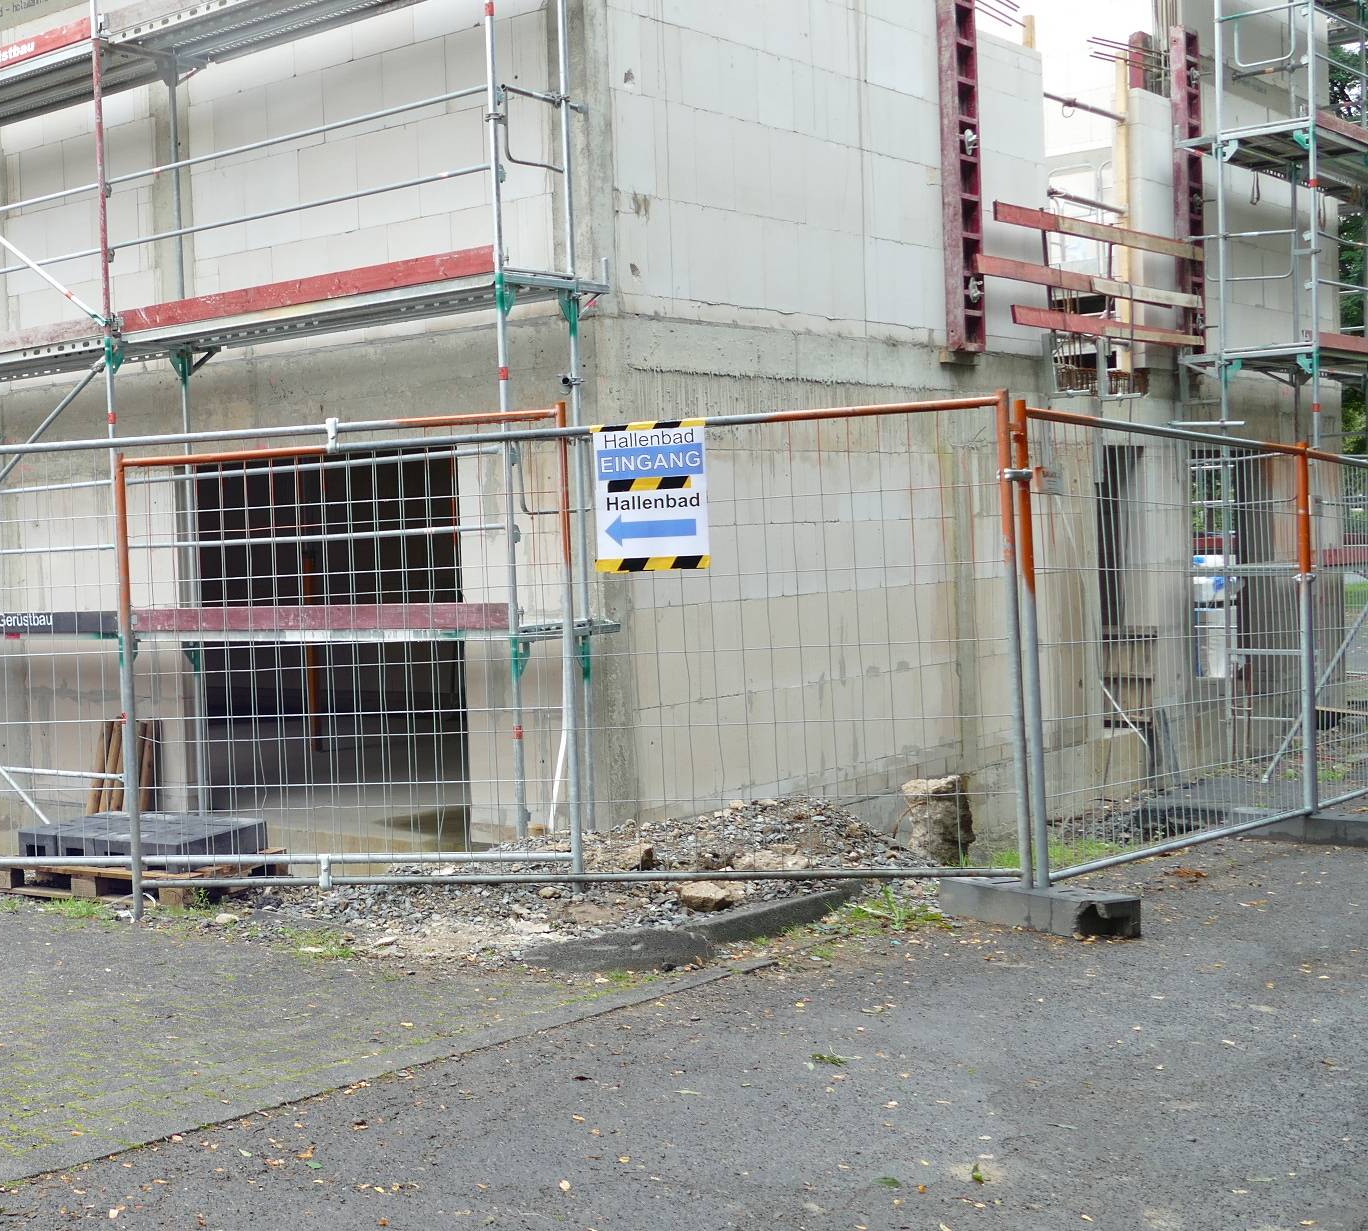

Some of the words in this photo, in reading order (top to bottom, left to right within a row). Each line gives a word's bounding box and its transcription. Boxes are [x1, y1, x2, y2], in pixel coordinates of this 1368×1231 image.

[604, 428, 695, 449] Hallenbad
[600, 450, 701, 473] EINGANG
[606, 492, 701, 511] Hallenbad
